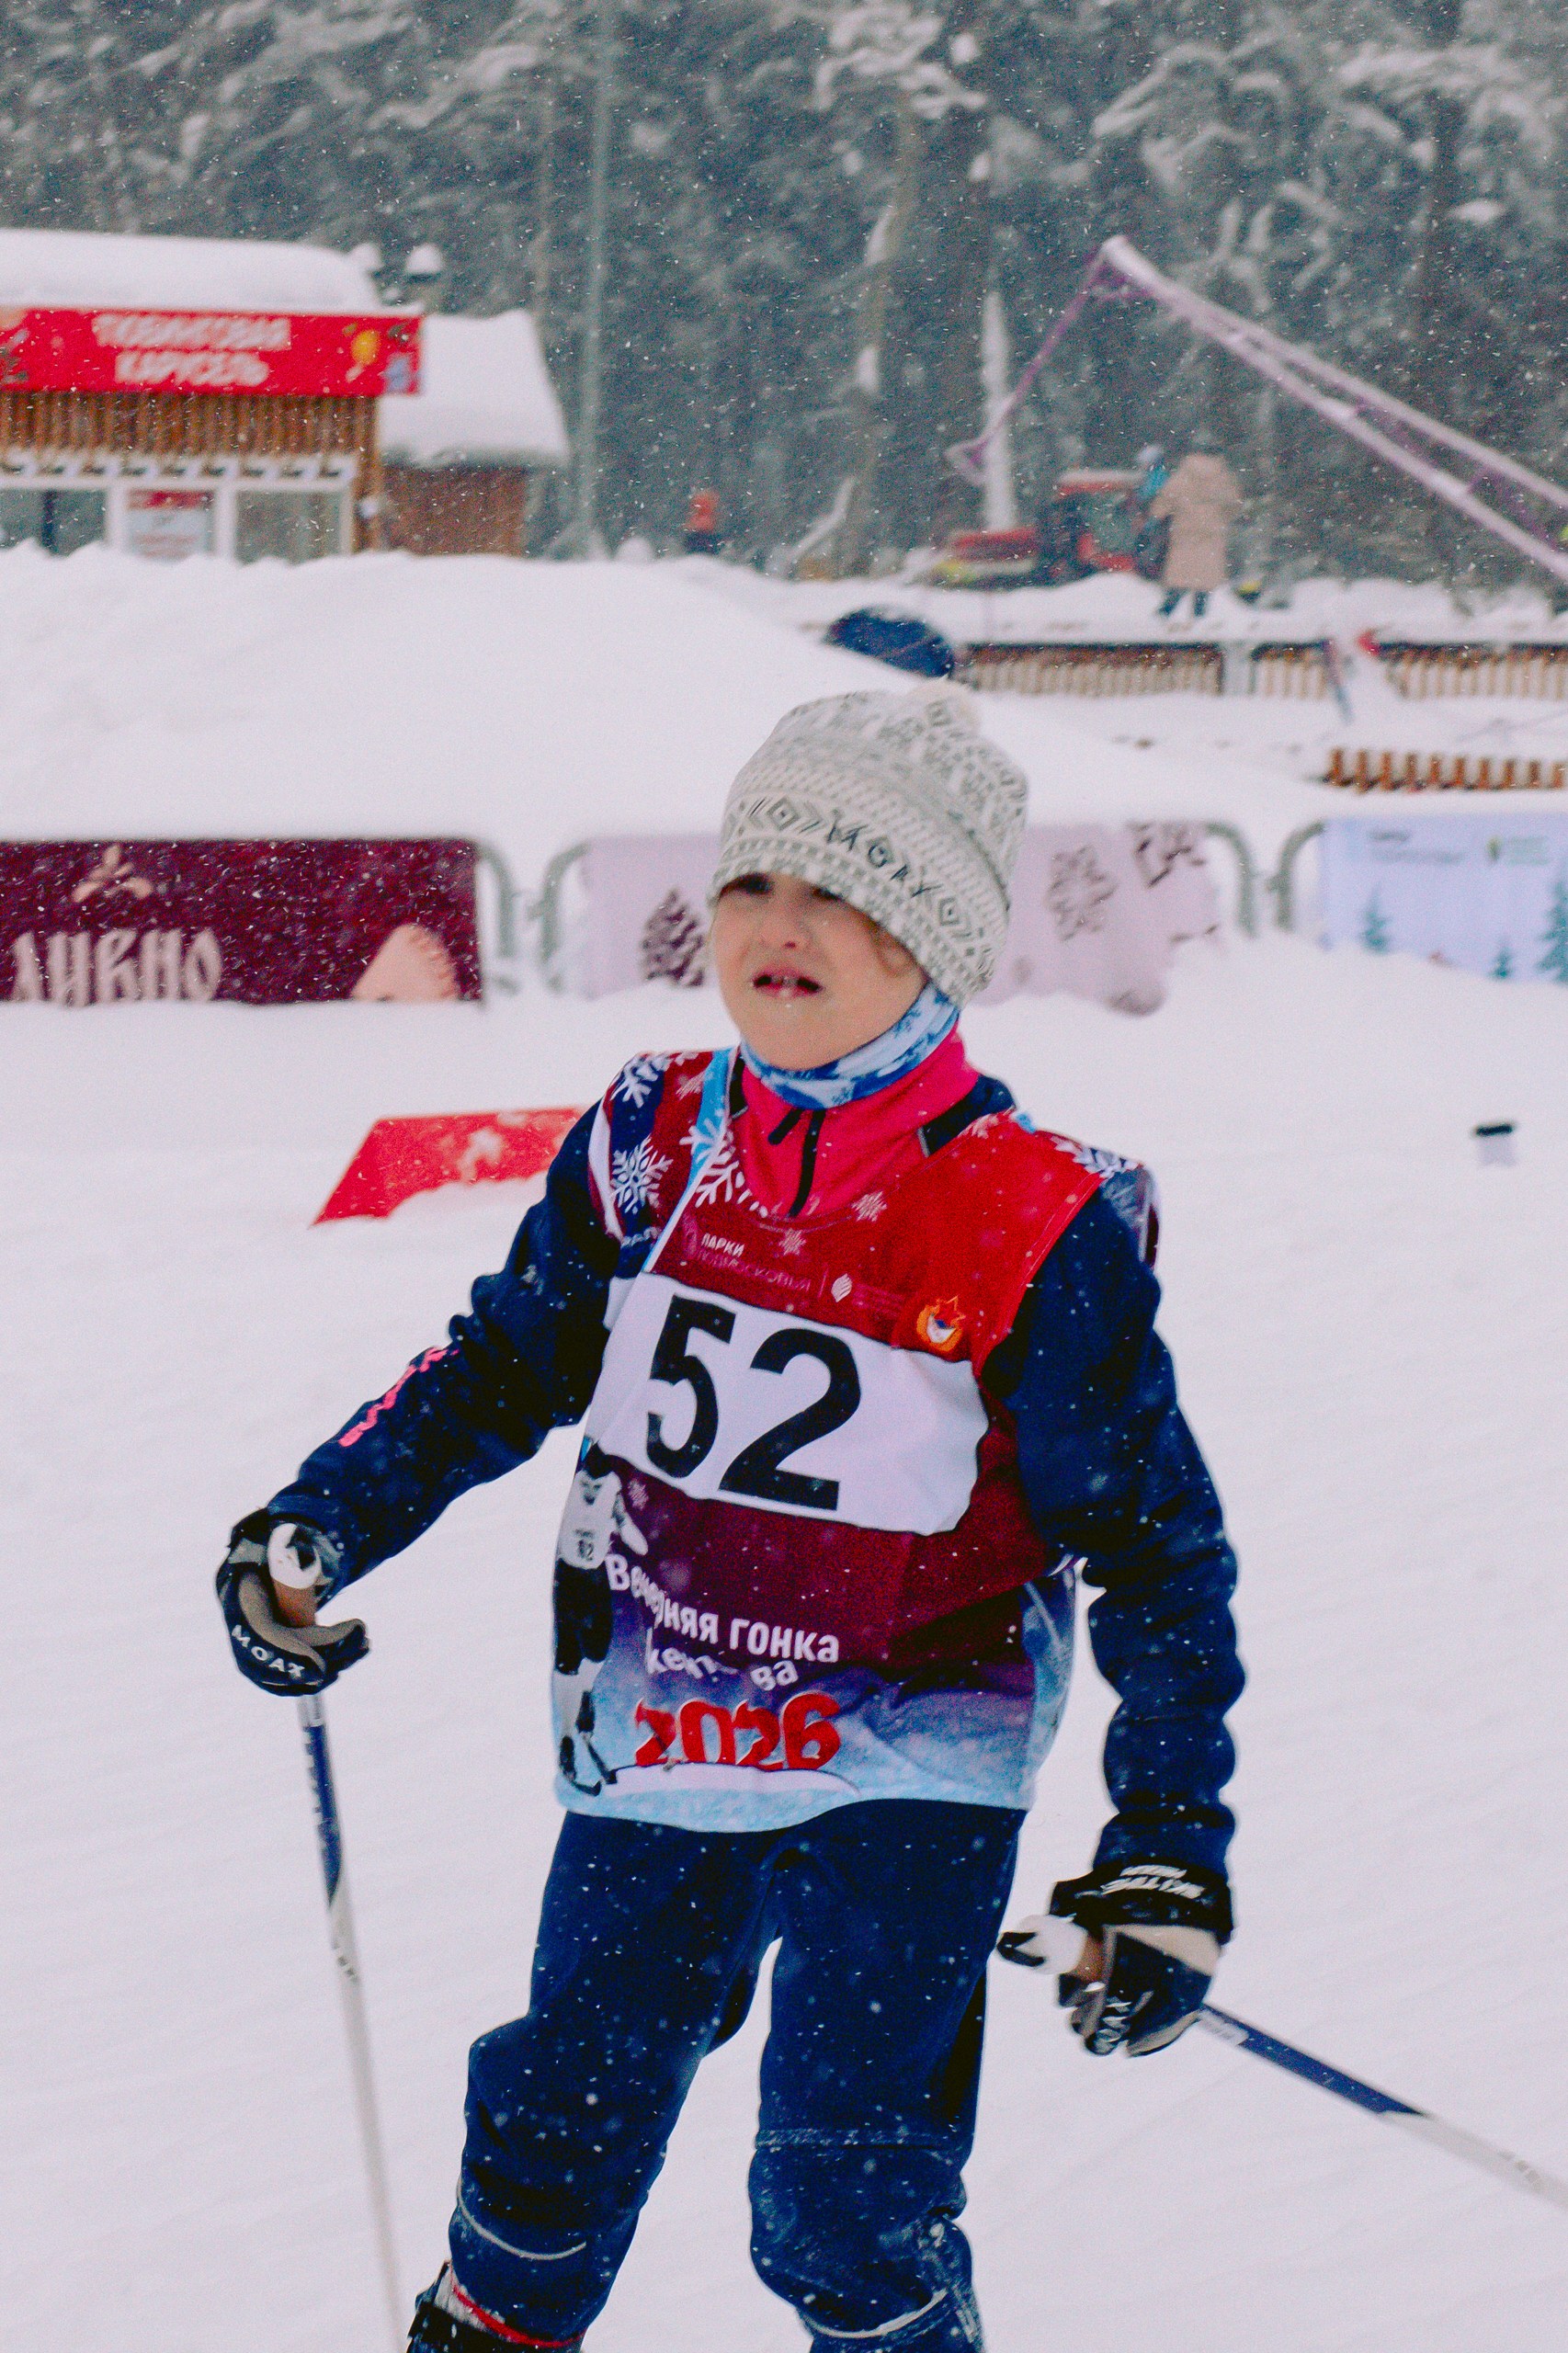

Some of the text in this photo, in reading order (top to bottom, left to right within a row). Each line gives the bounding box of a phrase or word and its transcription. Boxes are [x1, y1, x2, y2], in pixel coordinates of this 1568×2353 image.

[701, 1233, 744, 1258] ПАРКИ
[645, 1295, 862, 1511] 52
[634, 1691, 841, 1771] 2026
